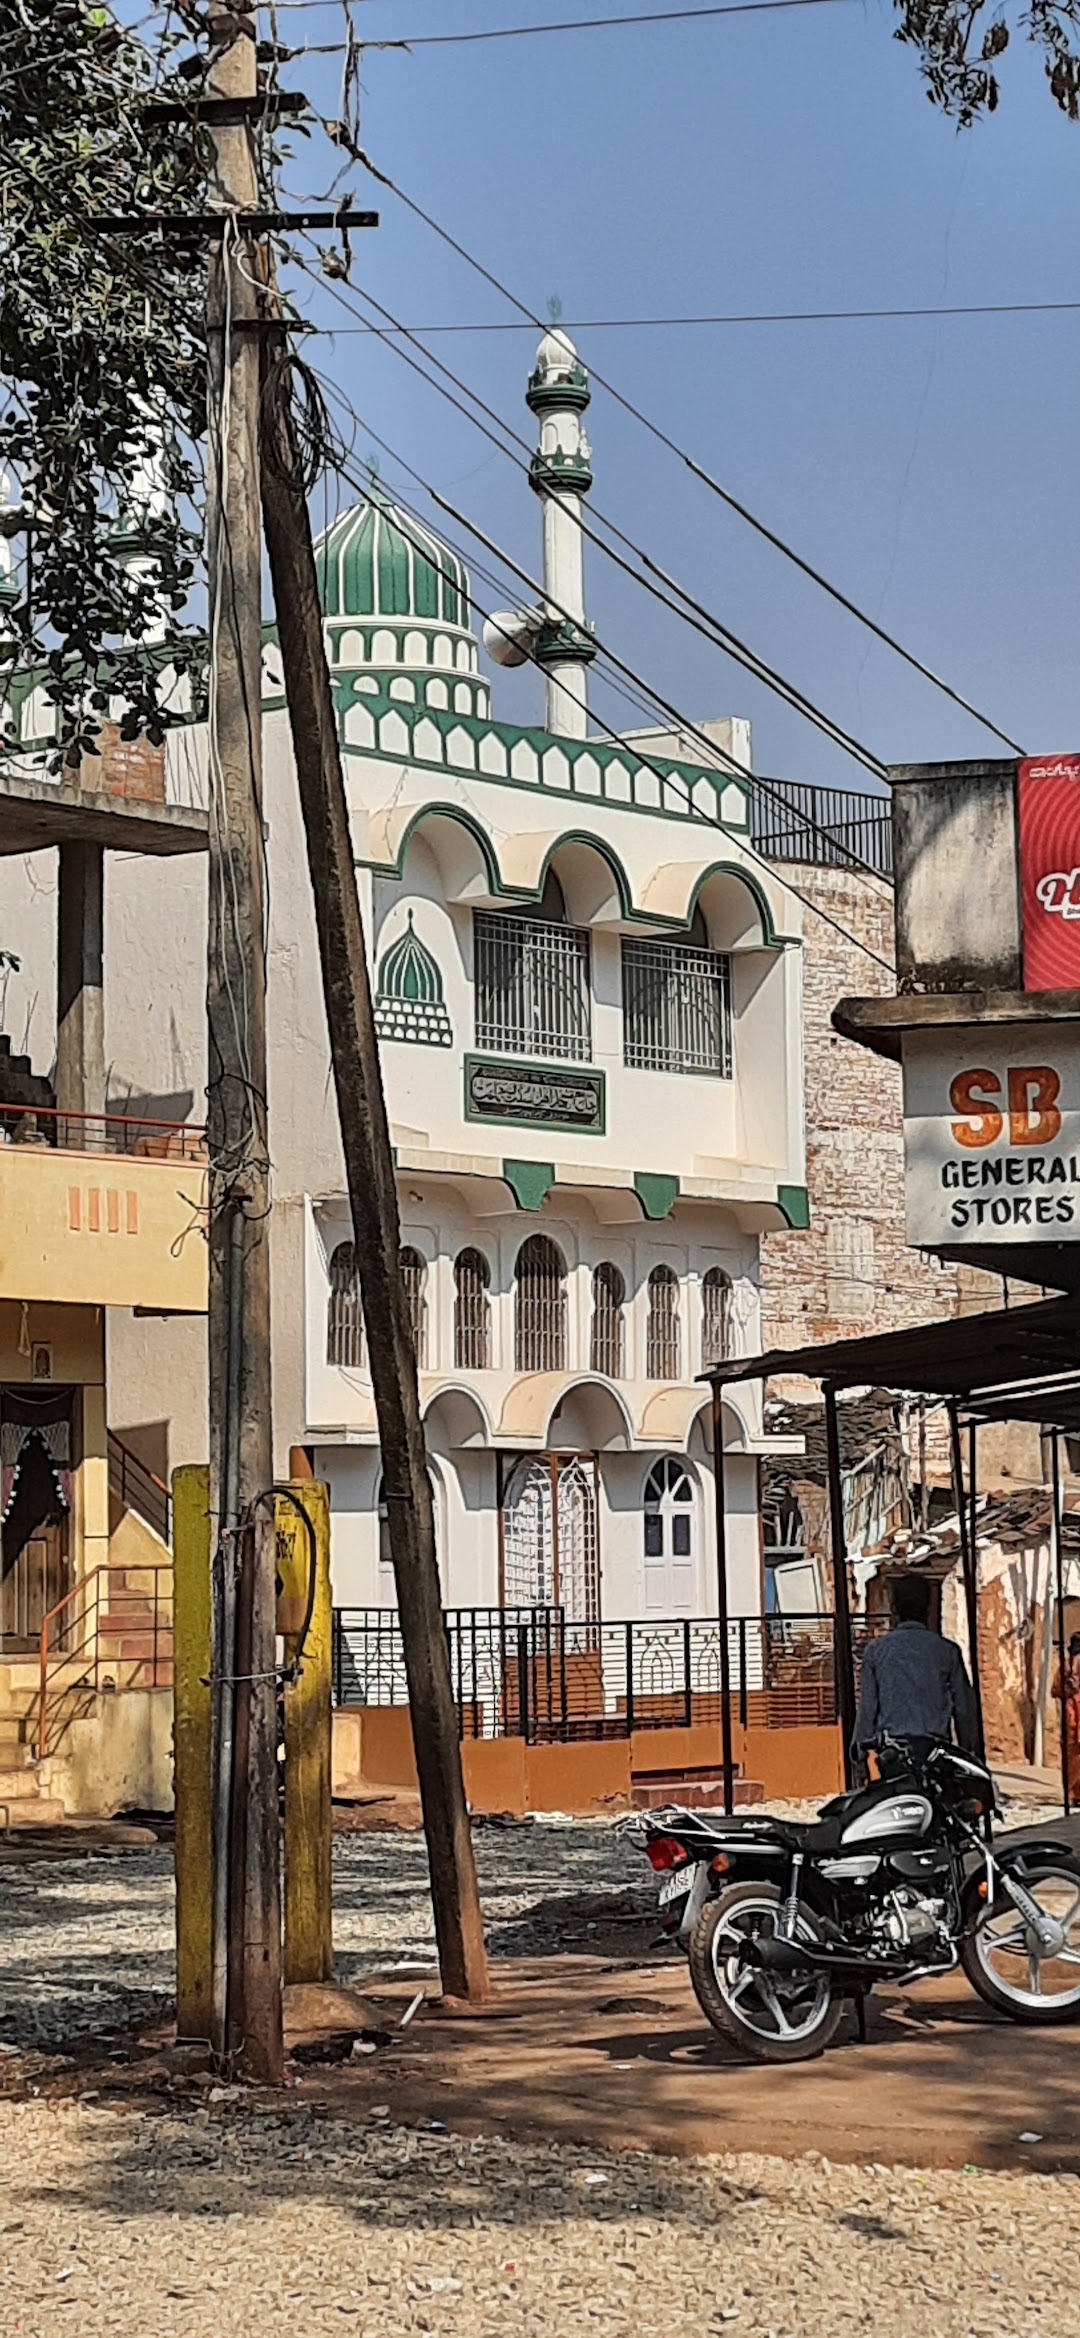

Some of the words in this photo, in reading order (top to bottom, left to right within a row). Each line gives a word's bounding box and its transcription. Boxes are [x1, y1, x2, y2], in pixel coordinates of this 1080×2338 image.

[949, 1066, 1062, 1148] SB
[941, 1156, 1080, 1189] GENERAL
[951, 1195, 1075, 1228] STORES
